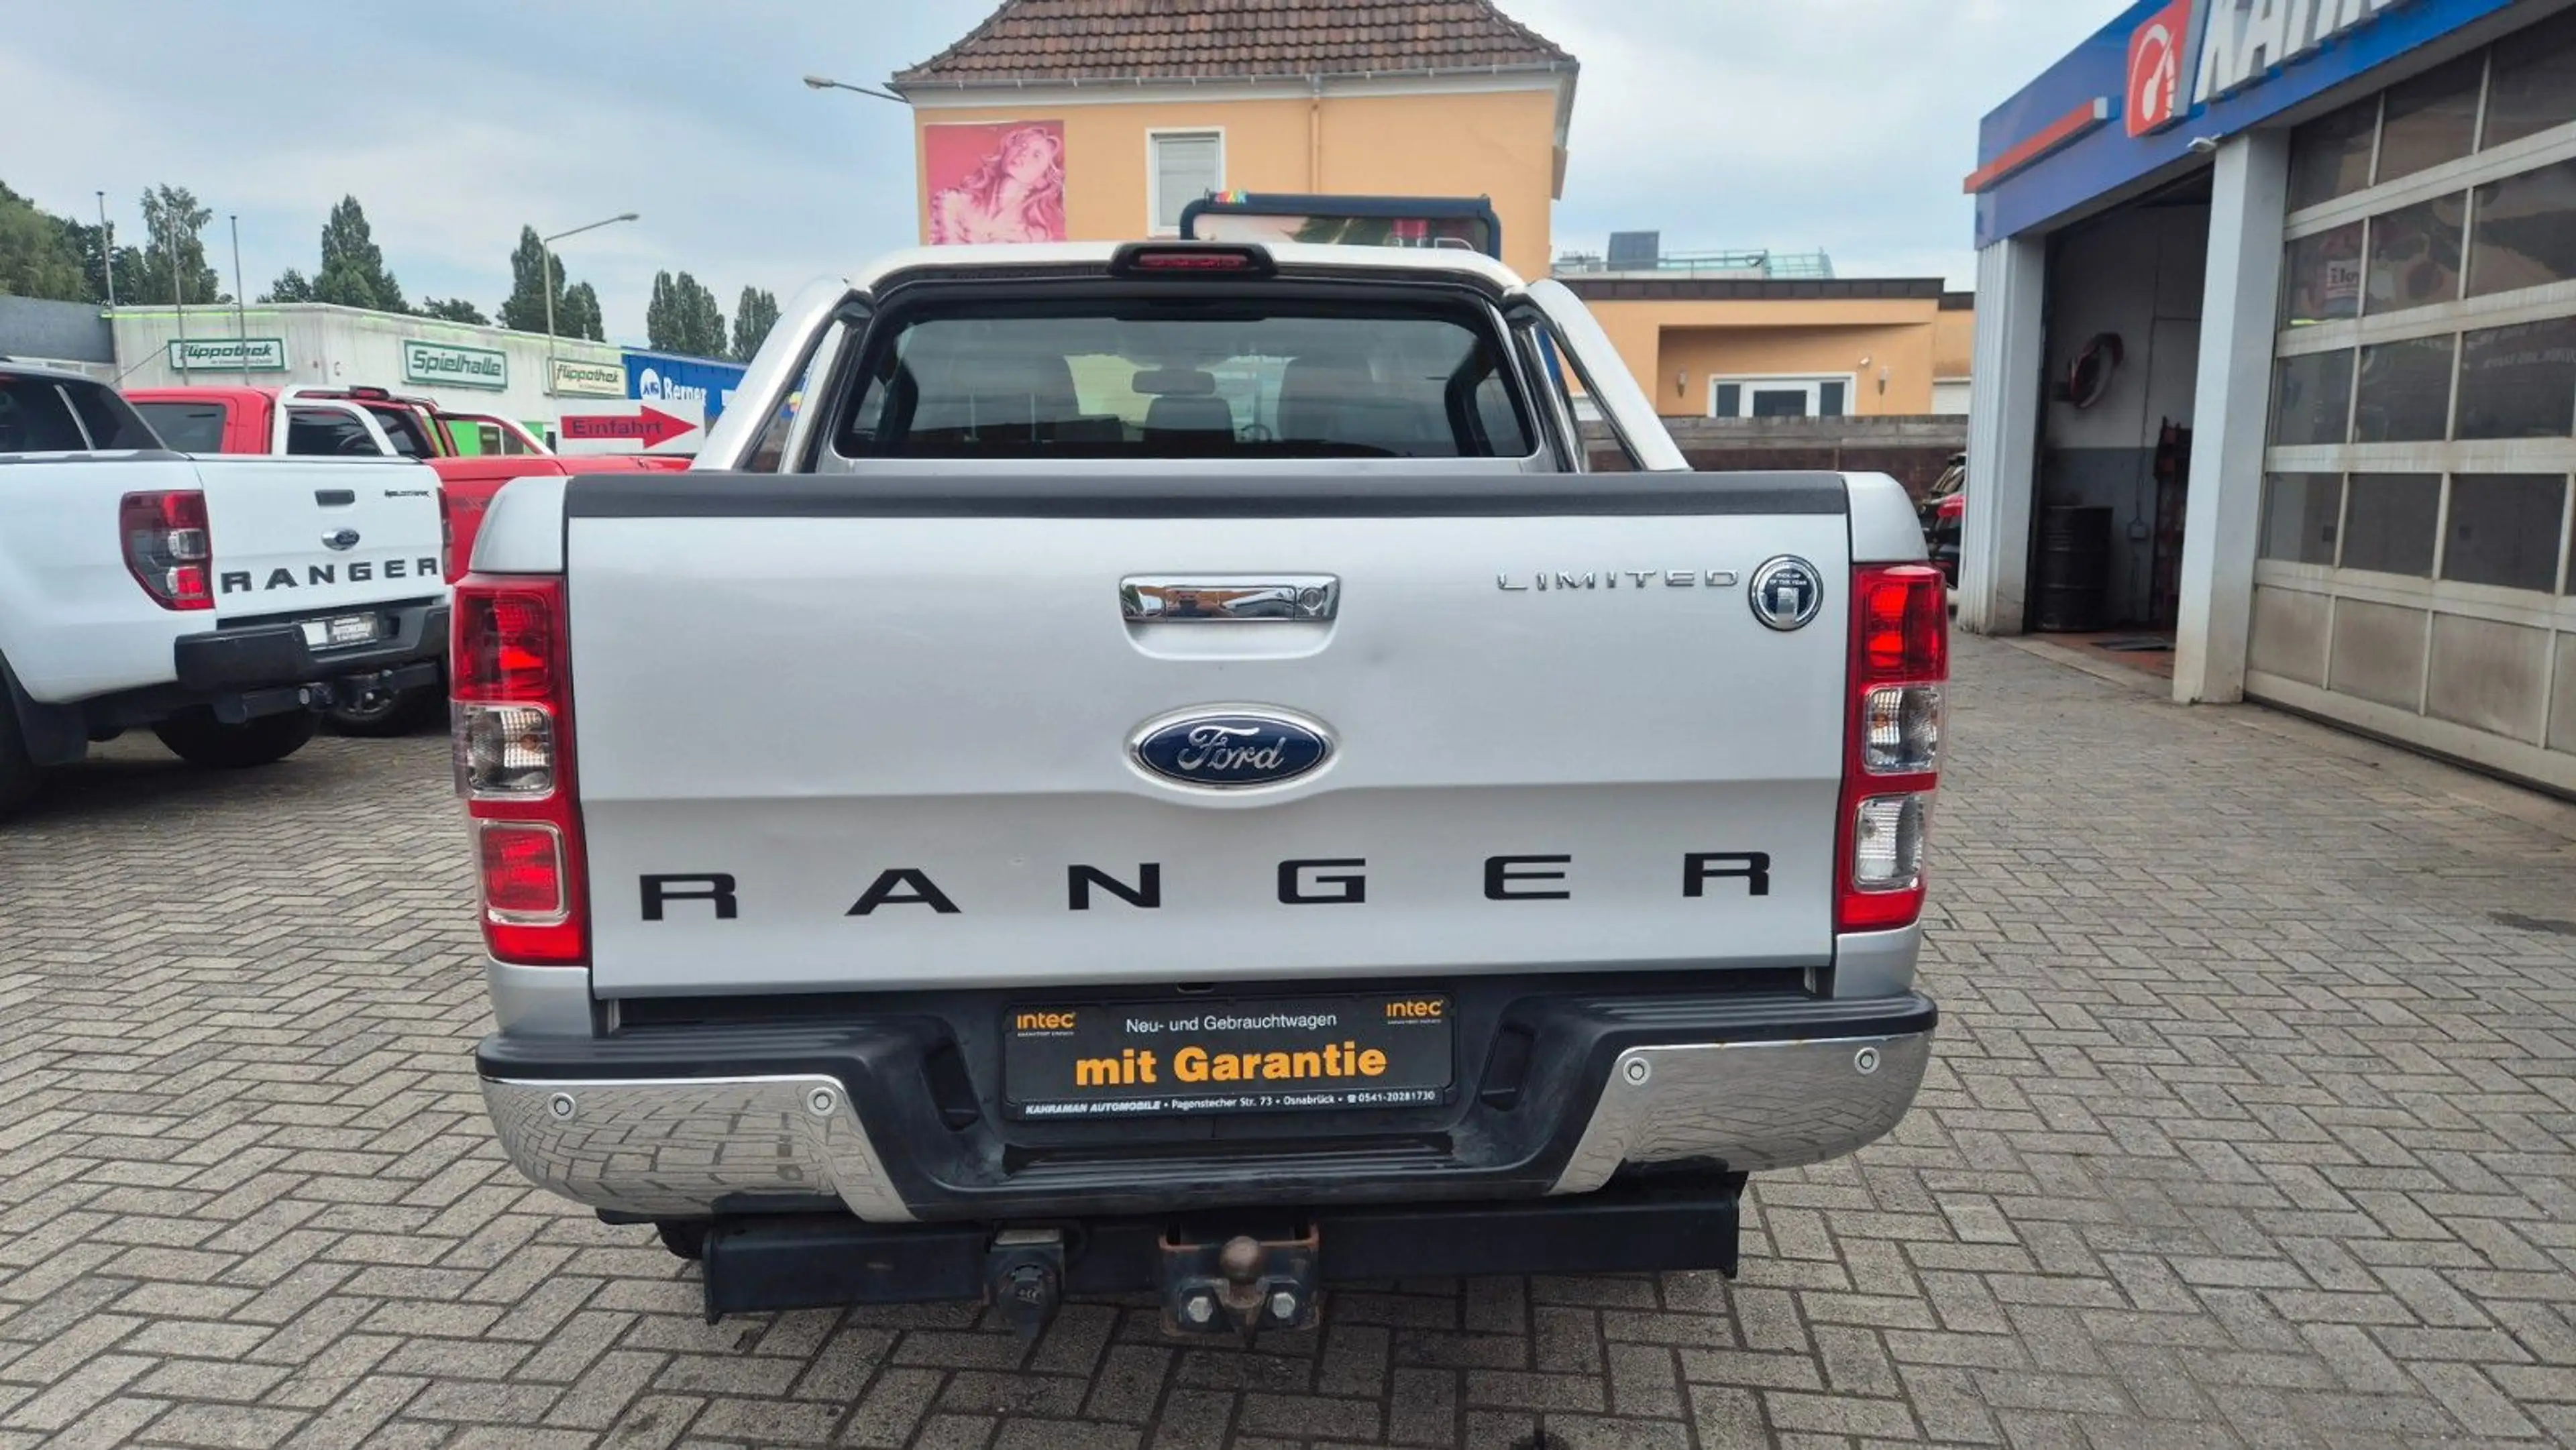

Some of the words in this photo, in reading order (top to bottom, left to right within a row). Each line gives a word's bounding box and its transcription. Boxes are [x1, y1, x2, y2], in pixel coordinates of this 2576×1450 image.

[413, 349, 502, 376] Spielhalle
[556, 364, 619, 382] flippothek
[572, 419, 663, 435] Einfahrt
[221, 557, 438, 594] RANGER
[1497, 567, 1739, 592] LIMITED
[1178, 726, 1287, 771] Ford
[639, 851, 1772, 922] RANGER
[1387, 999, 1444, 1018] intec
[1016, 1012, 1076, 1030] intec
[1126, 1017, 1165, 1034] Neu-
[1169, 1017, 1199, 1031] und
[1203, 1013, 1337, 1031] Gebrauchtwagen
[1076, 1048, 1157, 1086] mit
[1173, 1040, 1387, 1083] Garantie
[1025, 1103, 1087, 1115] KAHRAMAN
[1089, 1101, 1161, 1113] AUTOMOBILE
[1240, 1097, 1256, 1107] Str.
[1260, 1096, 1273, 1106] 73
[1283, 1095, 1335, 1106] Osnabrück
